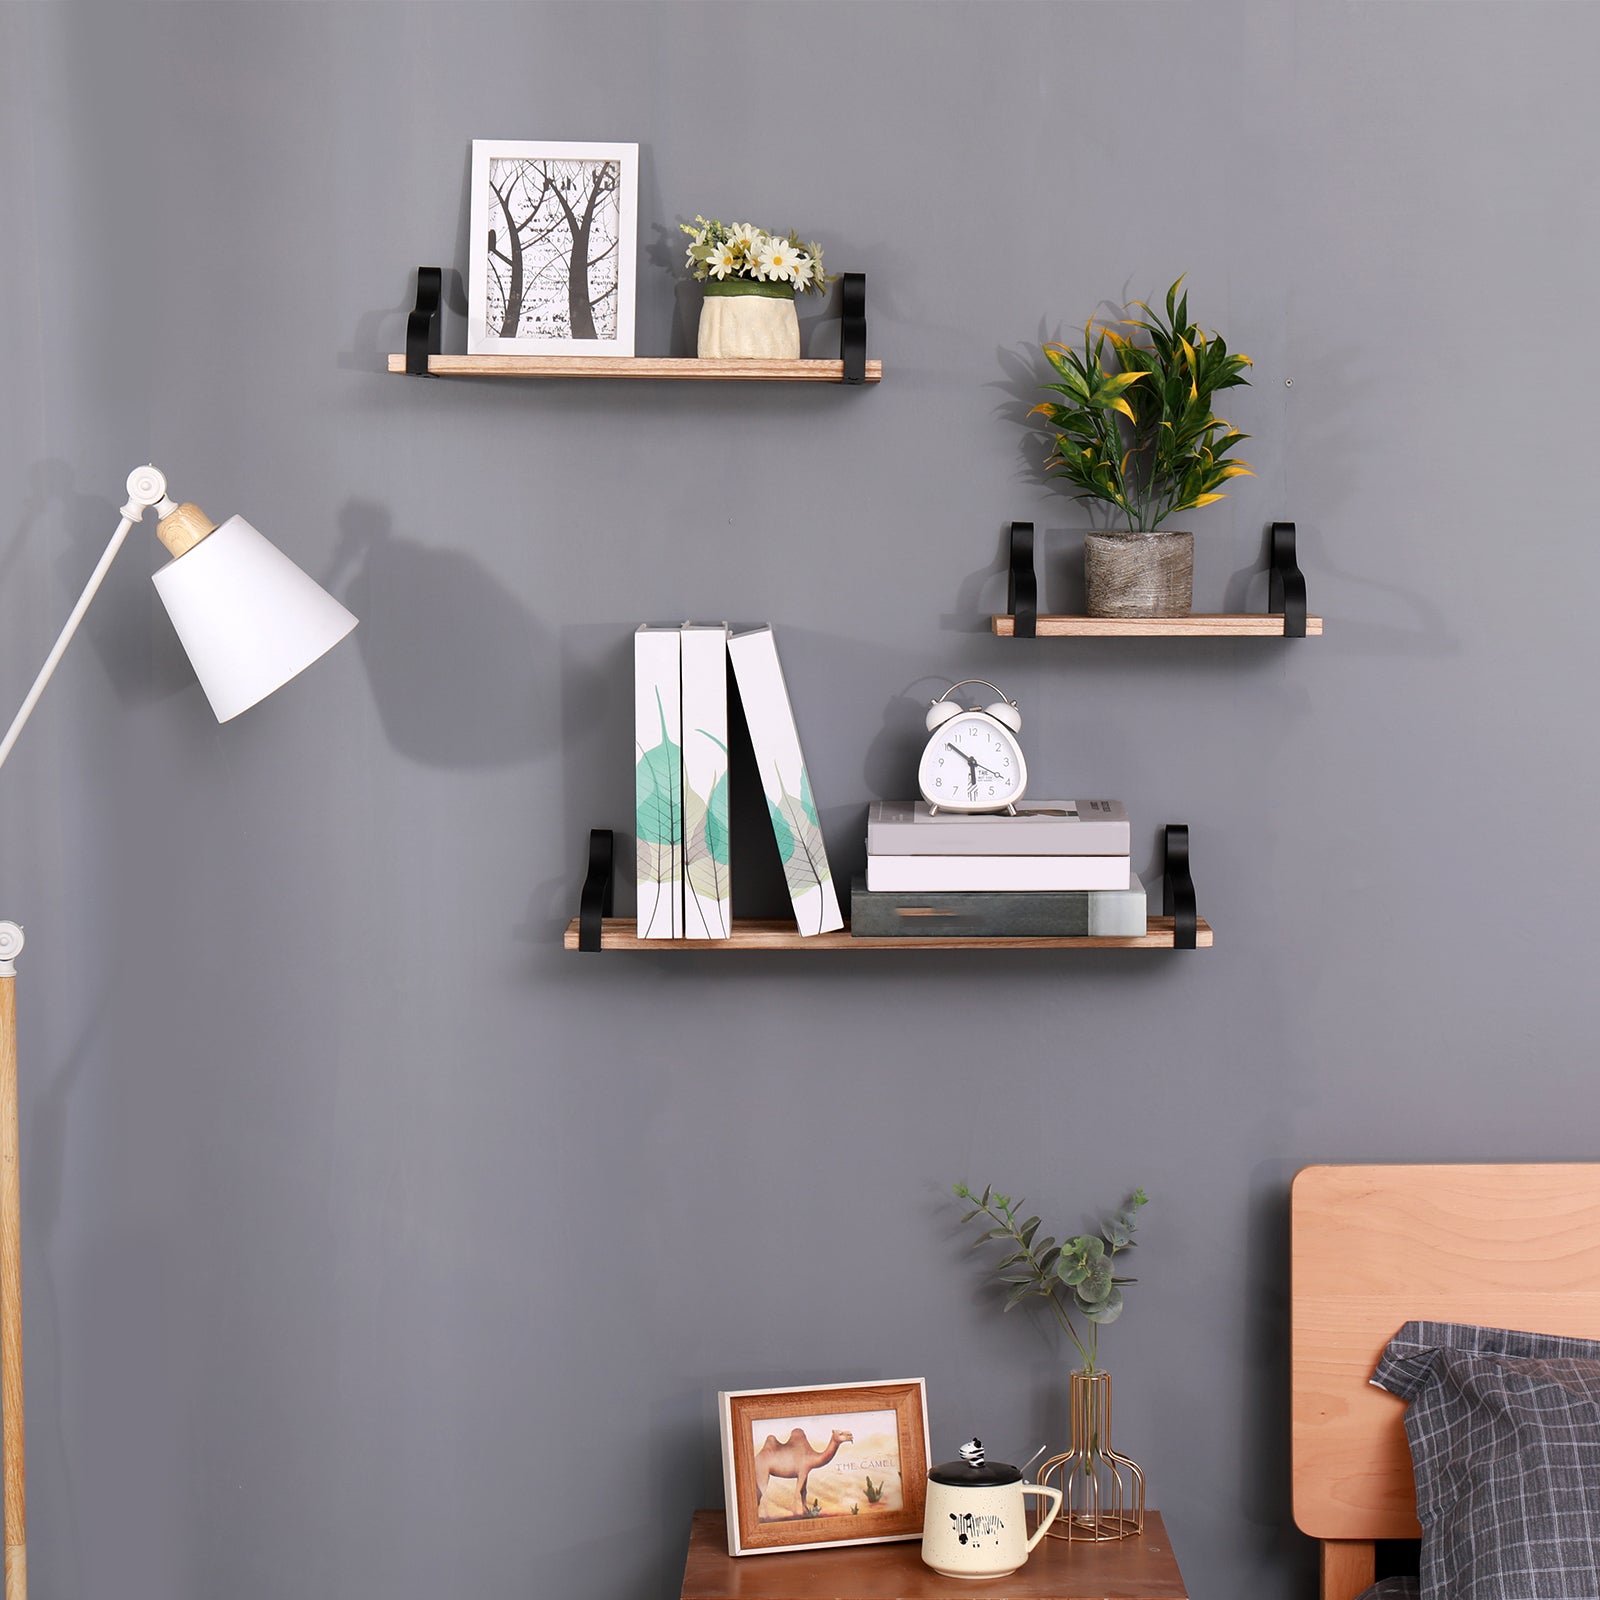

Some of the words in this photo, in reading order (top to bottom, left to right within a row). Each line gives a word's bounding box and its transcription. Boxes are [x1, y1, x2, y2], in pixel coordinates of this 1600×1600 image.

[968, 728, 978, 737] 12
[995, 742, 1002, 752] 2
[938, 758, 944, 767] 9
[1004, 758, 1010, 767] 3
[935, 778, 942, 787] 8
[952, 786, 958, 796] 7
[988, 786, 994, 796] 5
[836, 1462, 857, 1471] THE
[860, 1459, 896, 1470] CAMEL
